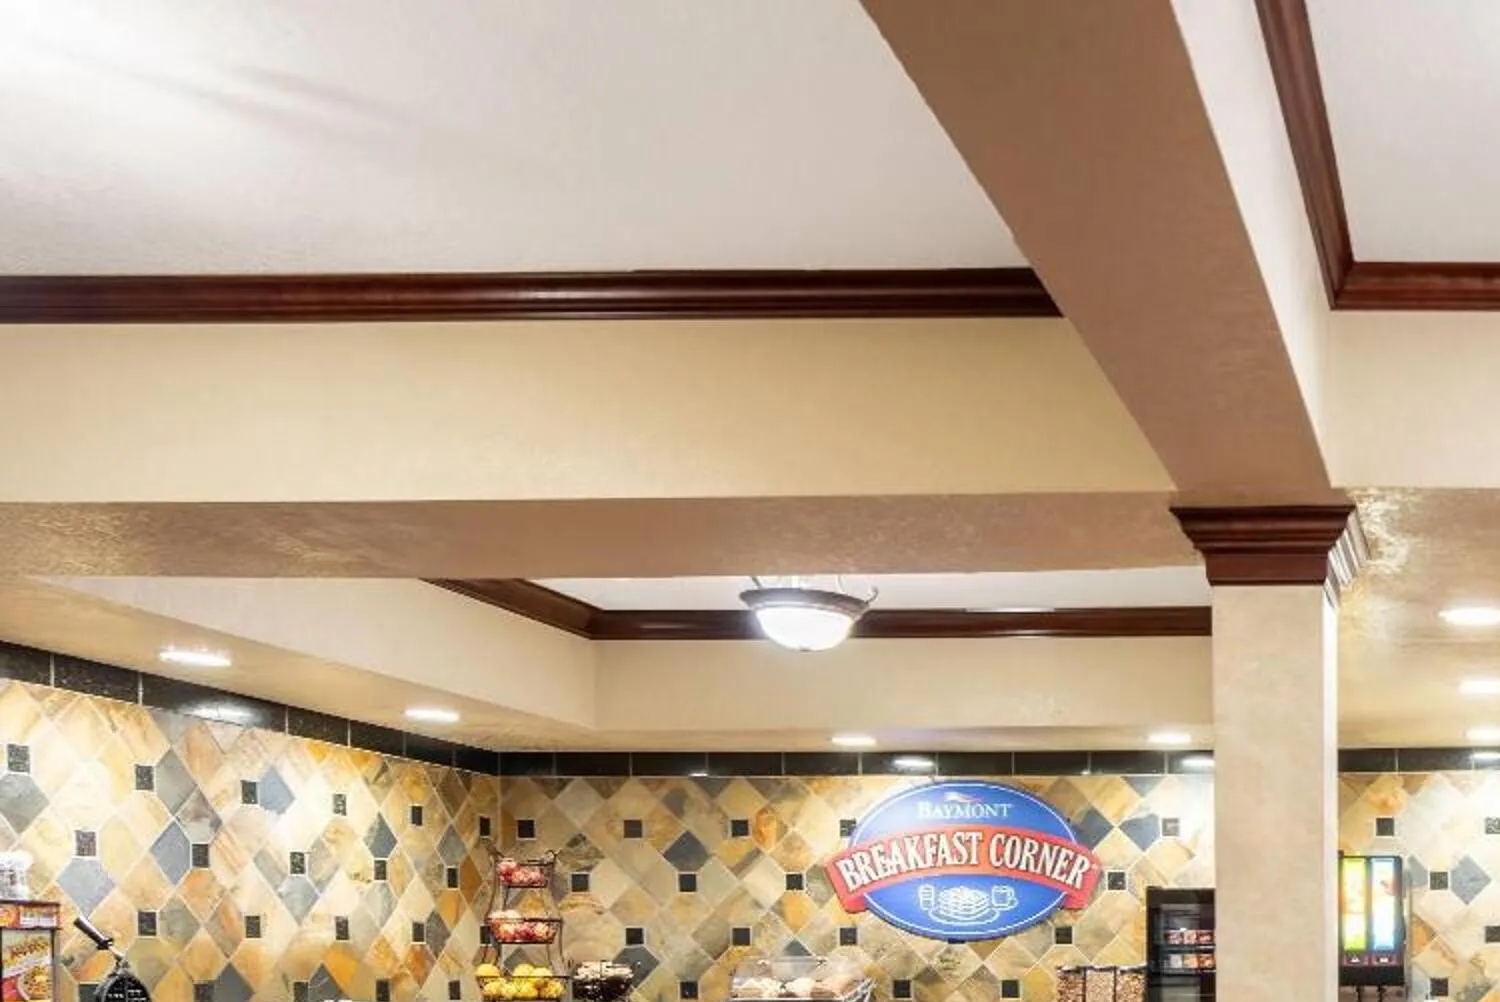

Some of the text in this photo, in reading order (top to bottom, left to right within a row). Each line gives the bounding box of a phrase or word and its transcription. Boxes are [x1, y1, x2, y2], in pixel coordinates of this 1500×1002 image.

[917, 802, 1011, 819] BAYMONT
[836, 831, 1091, 890] BREAKFAST CORNER
